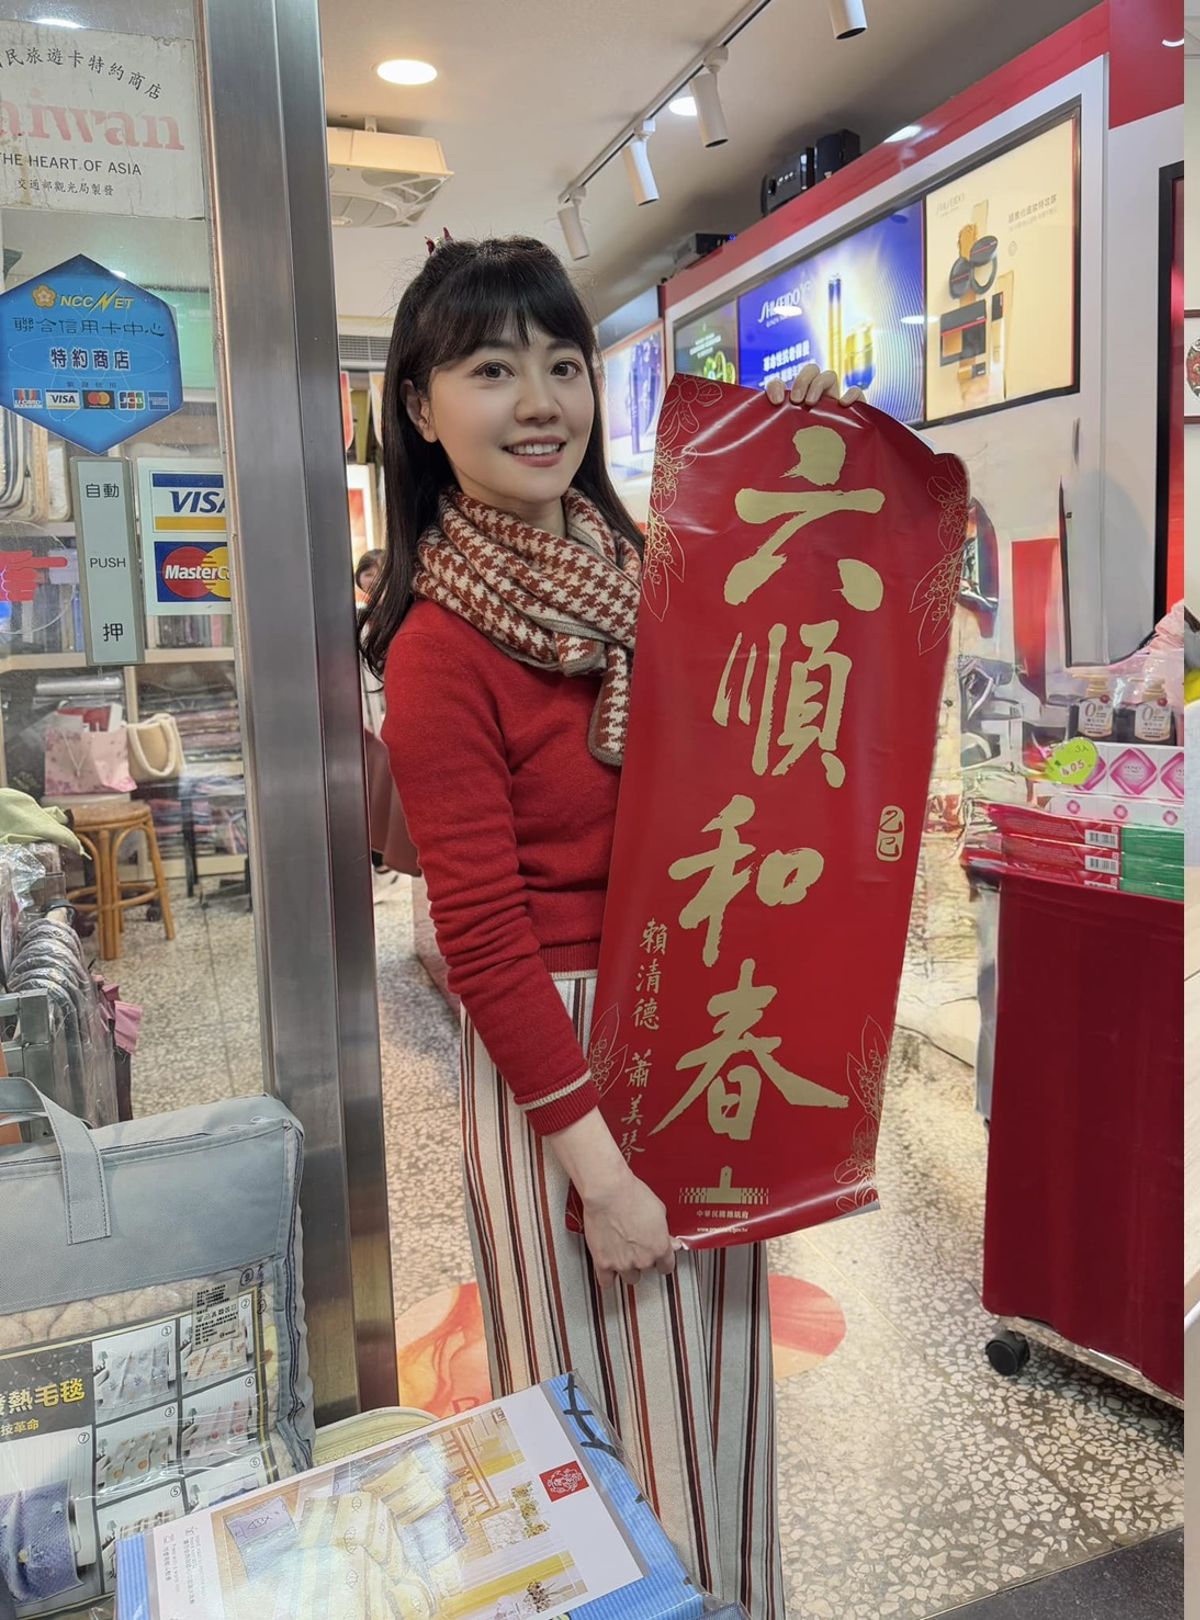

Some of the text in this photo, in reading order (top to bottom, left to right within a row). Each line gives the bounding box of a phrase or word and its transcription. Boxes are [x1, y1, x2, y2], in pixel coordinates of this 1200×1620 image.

[0, 47, 163, 100] 民旅遊卡特約商店
[0, 152, 143, 176] HE HEART OF ASIA
[13, 317, 166, 338] 聯合信用卡中心
[51, 347, 131, 370] 特約商店
[51, 393, 77, 404] VISA
[85, 482, 120, 499] 自動
[89, 556, 127, 569] PUSH
[102, 622, 124, 642] 押
[647, 424, 887, 1141] 六順和春
[620, 917, 668, 1163] 賴清德 蕭美琴
